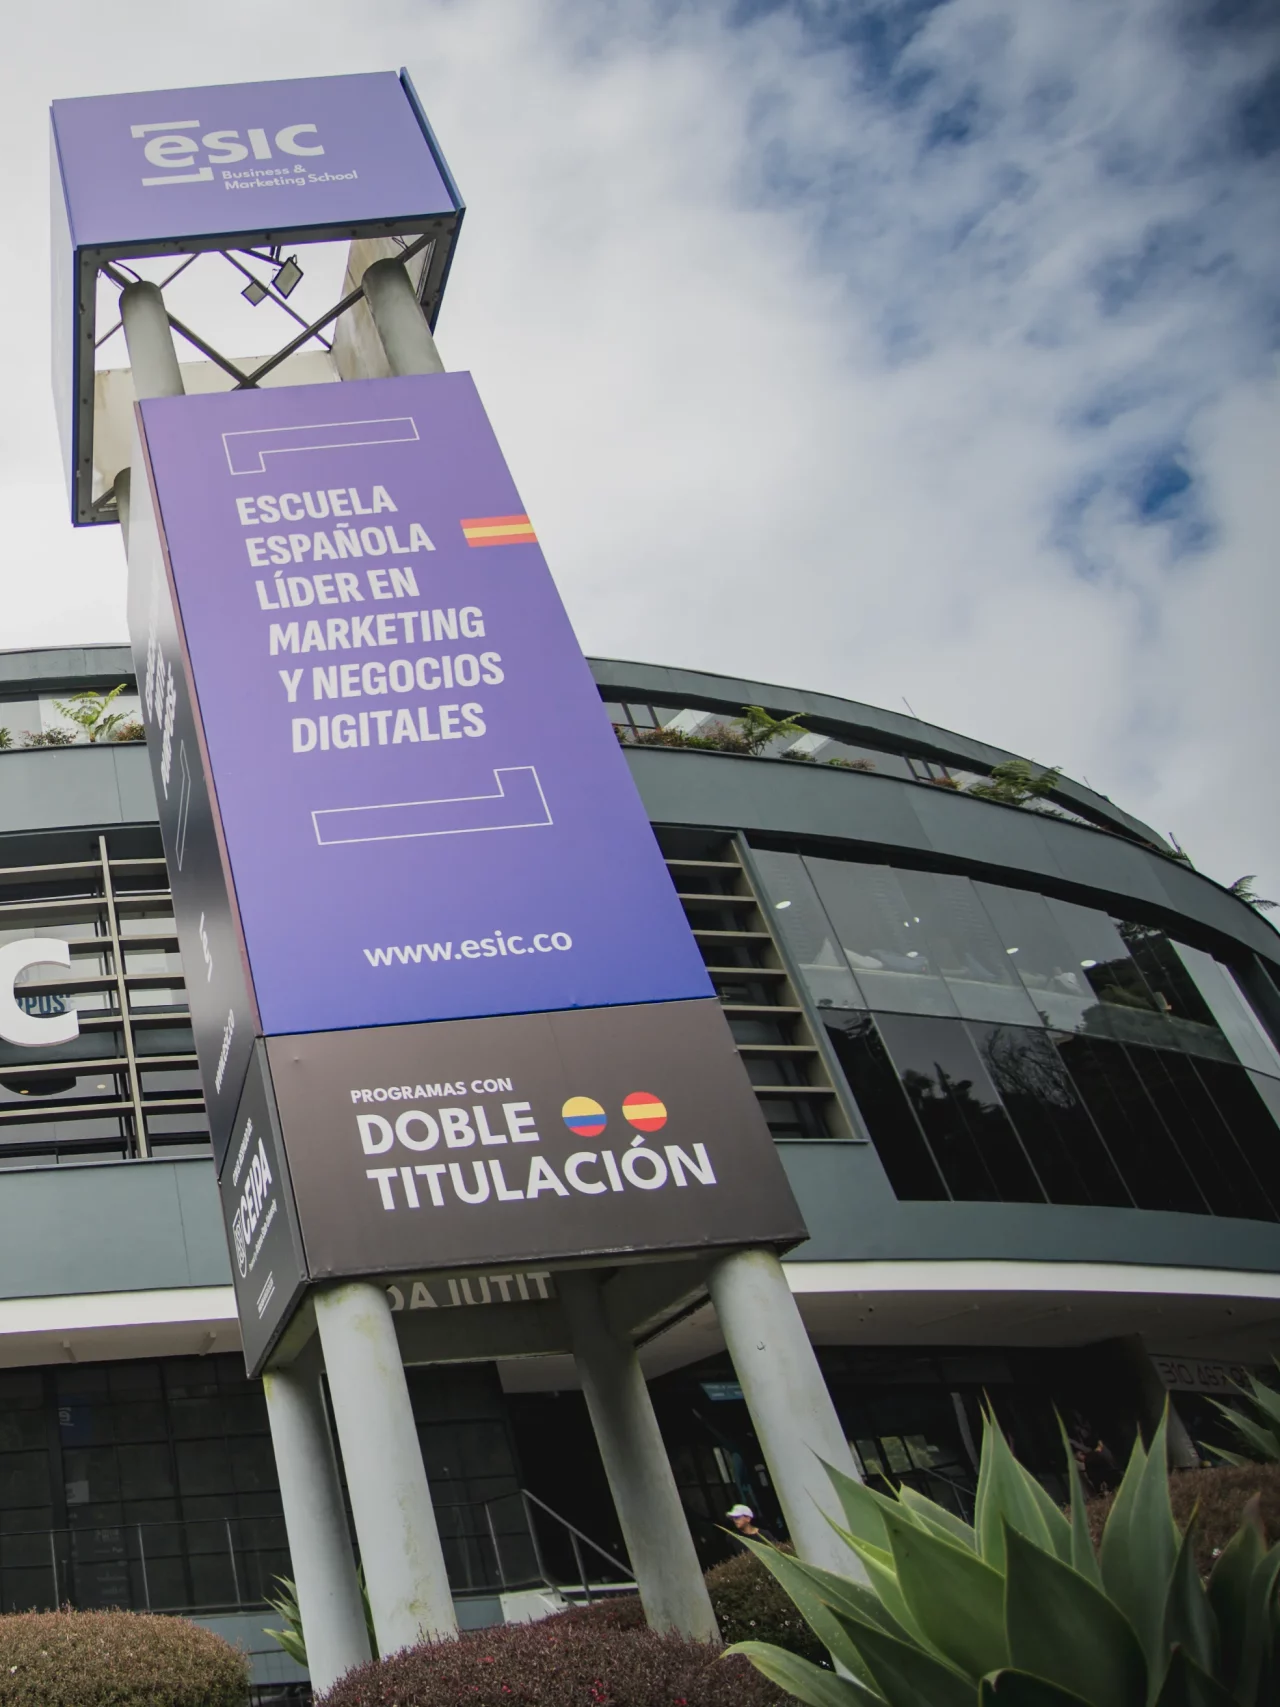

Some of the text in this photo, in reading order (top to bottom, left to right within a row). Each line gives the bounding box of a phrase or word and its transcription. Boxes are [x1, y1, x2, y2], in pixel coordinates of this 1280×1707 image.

[222, 164, 307, 181] Business &
[224, 169, 358, 191] Marketing School
[236, 486, 397, 525] ESCUELA
[246, 523, 435, 566] ESPAÑOLA
[256, 567, 419, 610] LÍDER EN
[270, 607, 485, 655] MARKETING
[279, 652, 504, 702] Y NEGOCIOS
[292, 703, 486, 752] DIGITALES
[363, 931, 572, 966] www.esic.co
[350, 1078, 513, 1104] PROGRAMAS CON
[356, 1102, 539, 1154] DOBLE
[239, 1136, 273, 1246] CEIPA
[366, 1135, 716, 1210] TITULACIÓN
